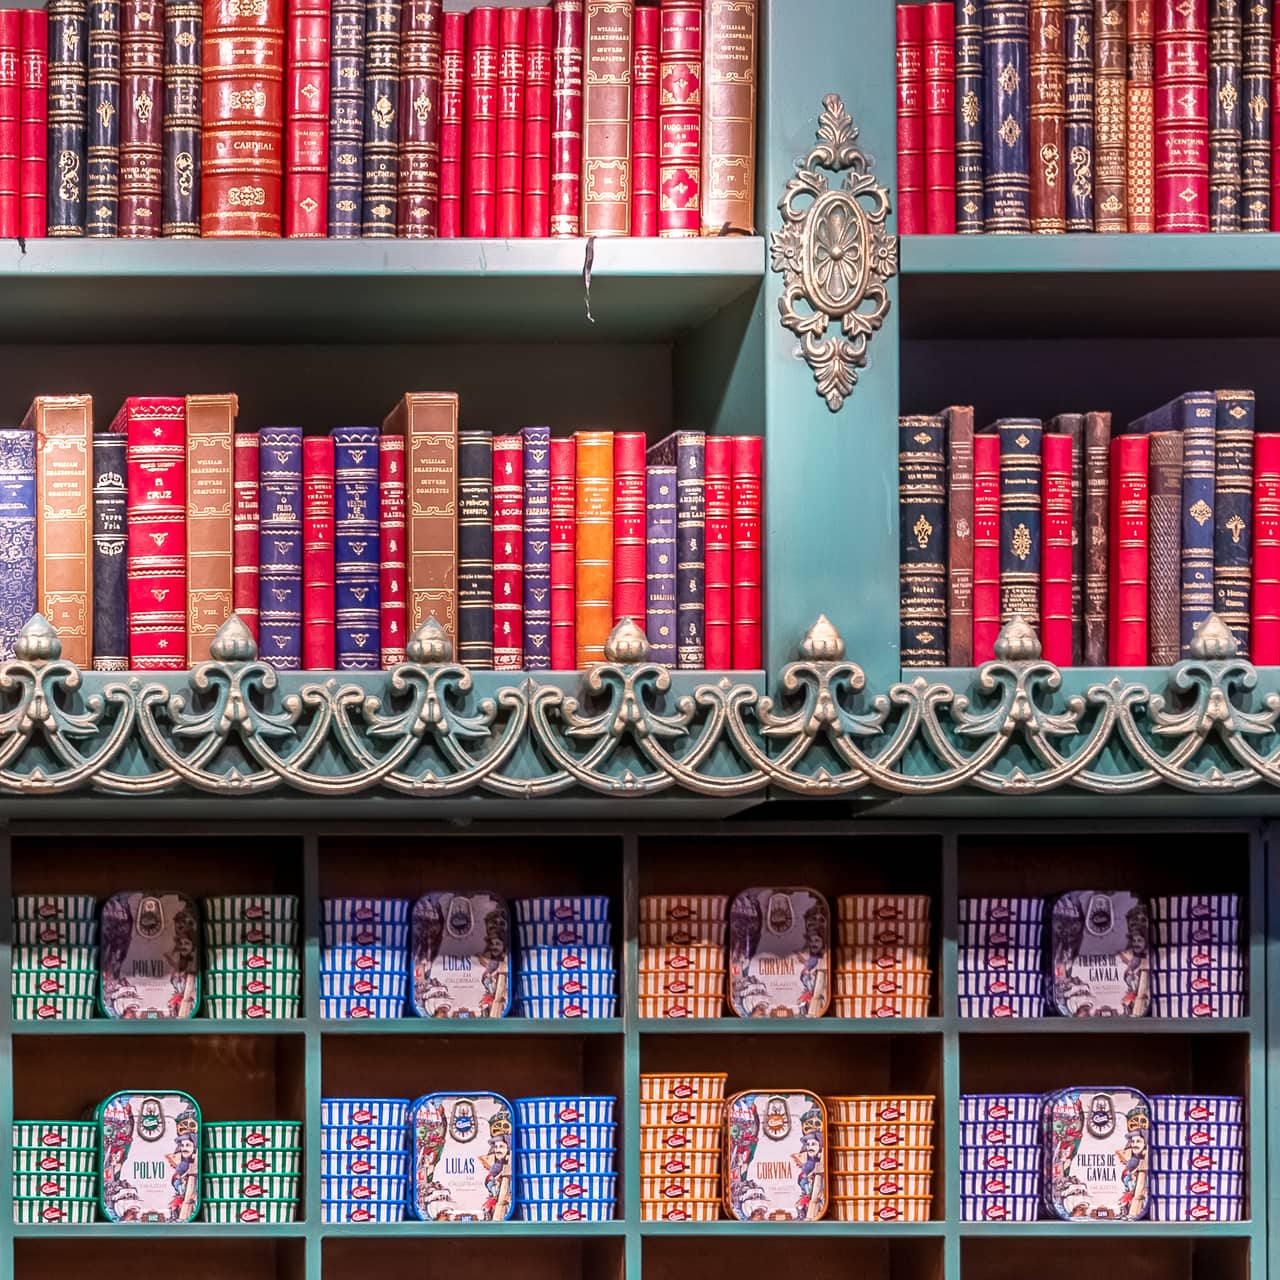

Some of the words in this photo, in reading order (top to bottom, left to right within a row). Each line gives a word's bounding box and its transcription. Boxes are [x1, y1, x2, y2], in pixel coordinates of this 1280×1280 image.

[133, 960, 164, 978] POLVO
[442, 955, 471, 971] LULAS
[758, 959, 795, 975] CORVINA
[1089, 968, 1119, 982] CAVALA
[445, 1158, 475, 1174] LULAS
[1077, 1154, 1105, 1167] FILETES
[1107, 1154, 1116, 1167] DE
[134, 1162, 164, 1179] POLVO
[757, 1162, 792, 1180] CORVINA
[1087, 1168, 1116, 1182] CAVALA
